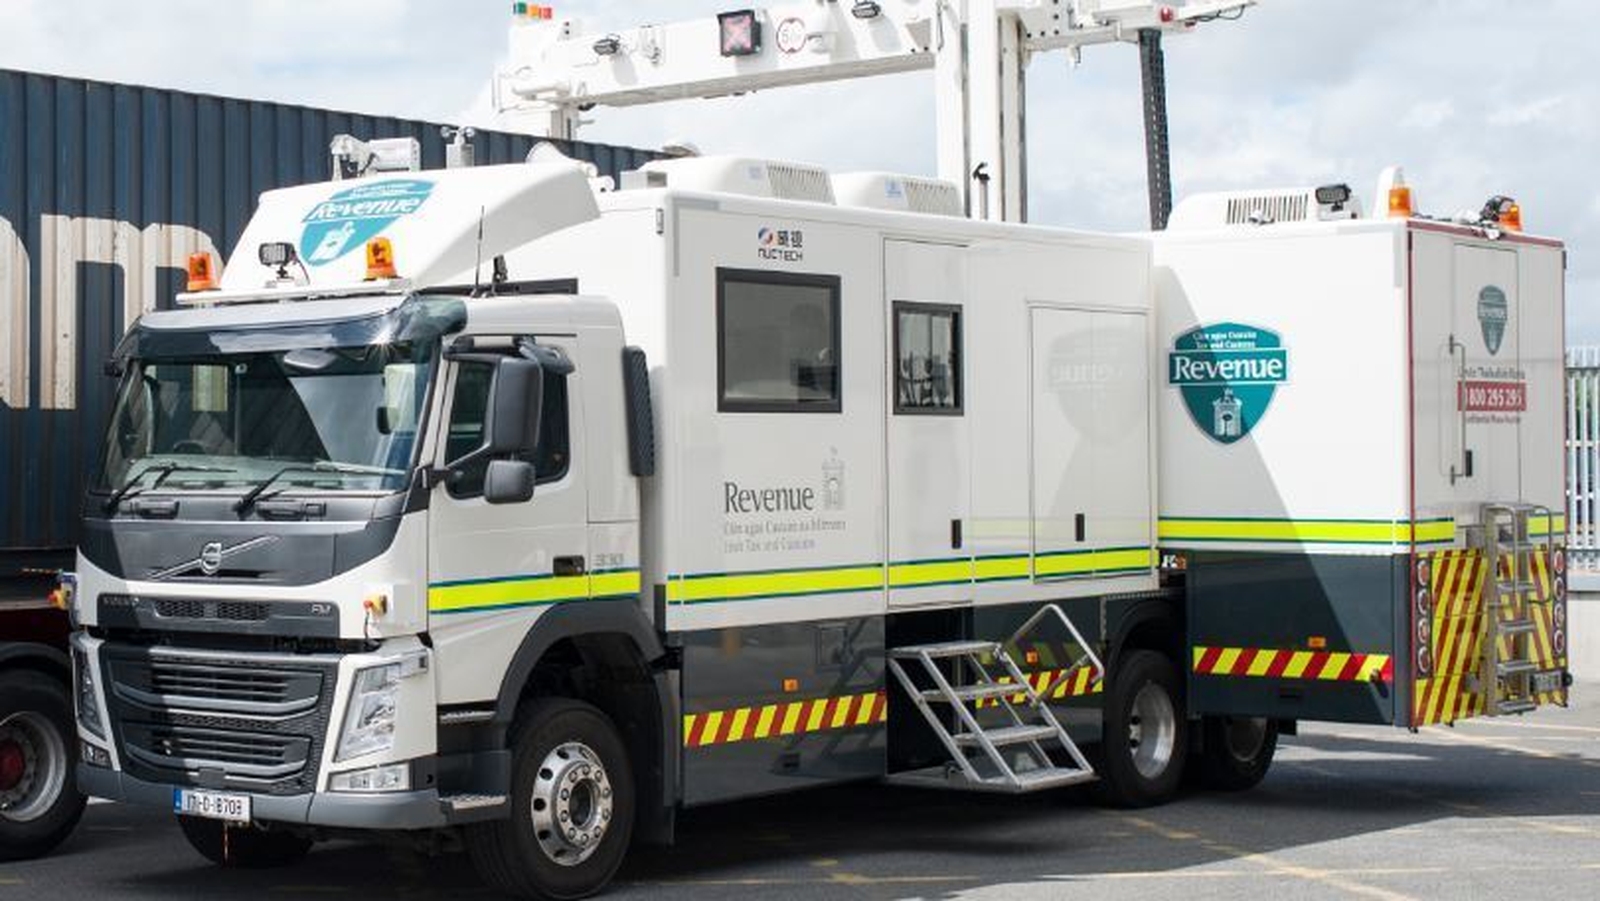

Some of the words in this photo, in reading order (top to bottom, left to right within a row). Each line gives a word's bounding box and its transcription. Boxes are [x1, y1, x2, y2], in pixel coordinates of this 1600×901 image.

[307, 197, 421, 220] Revenue
[1174, 356, 1283, 380] Revenue
[724, 481, 814, 513] Revenue
